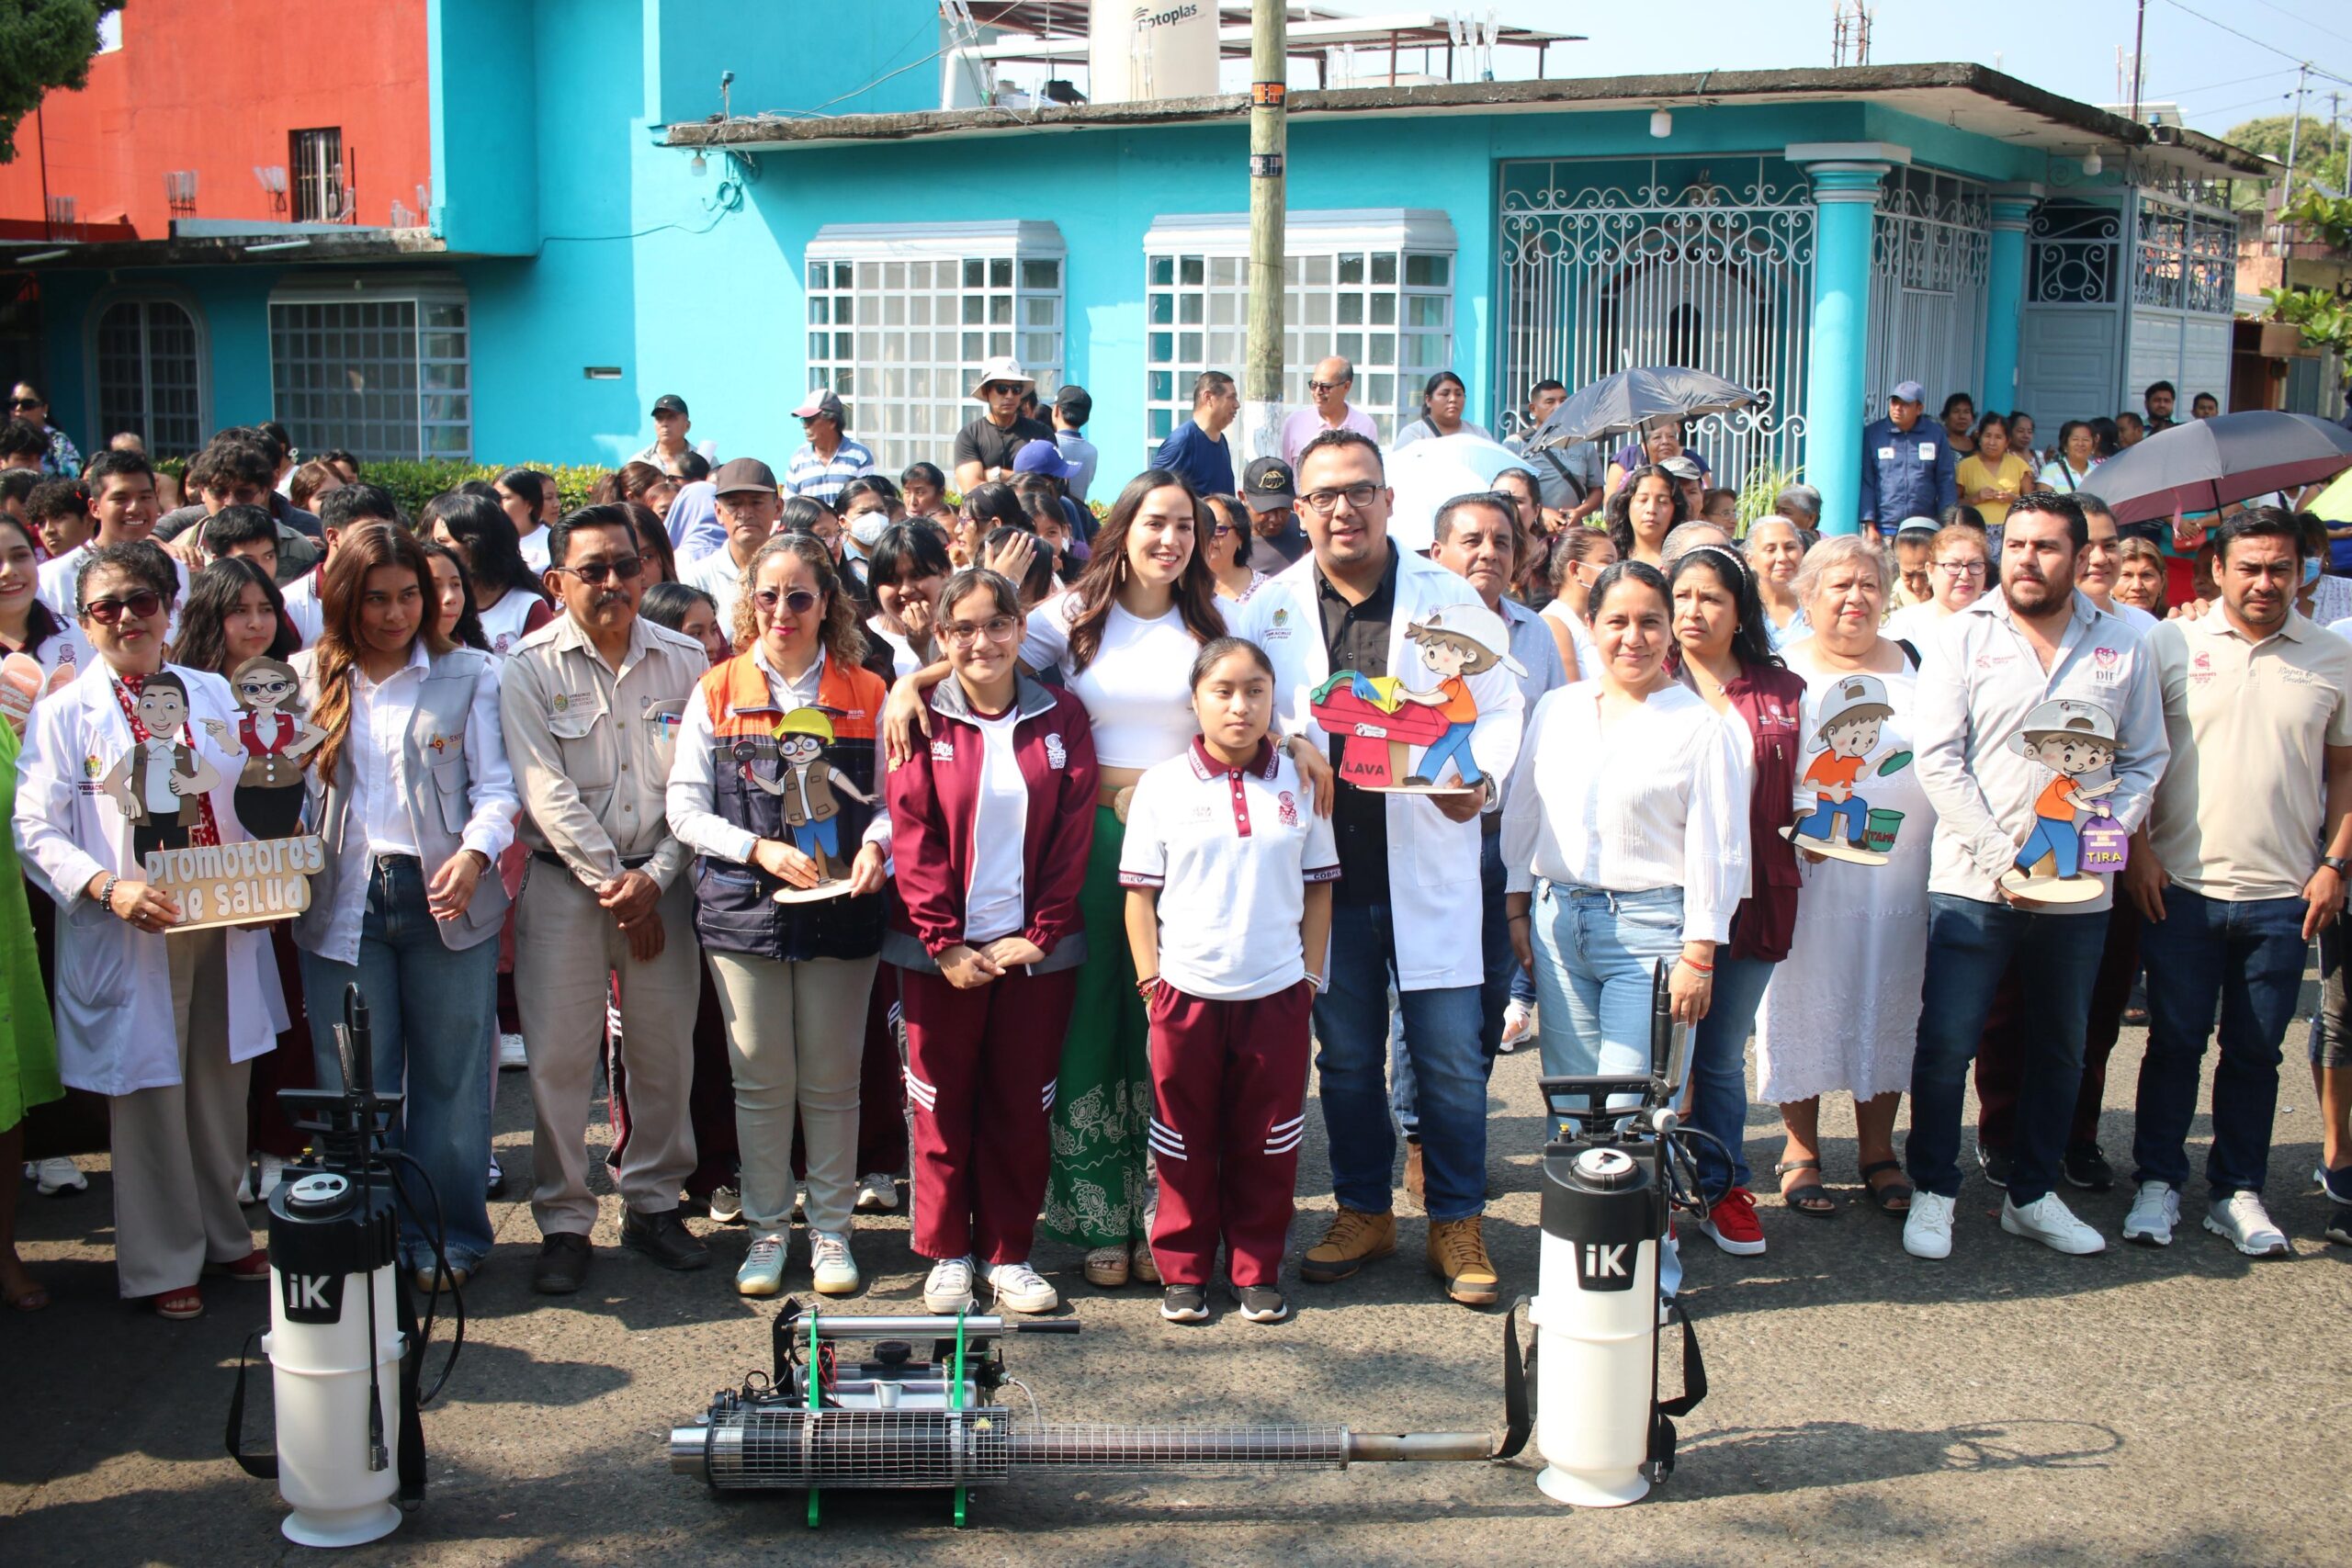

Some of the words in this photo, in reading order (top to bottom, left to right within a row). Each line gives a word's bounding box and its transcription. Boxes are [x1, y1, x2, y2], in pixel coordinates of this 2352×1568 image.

[1345, 761, 1385, 775] LAVA
[2086, 852, 2123, 863] TIRA
[172, 887, 204, 922] de
[1585, 1244, 1628, 1278] iK
[288, 1273, 332, 1310] iK
